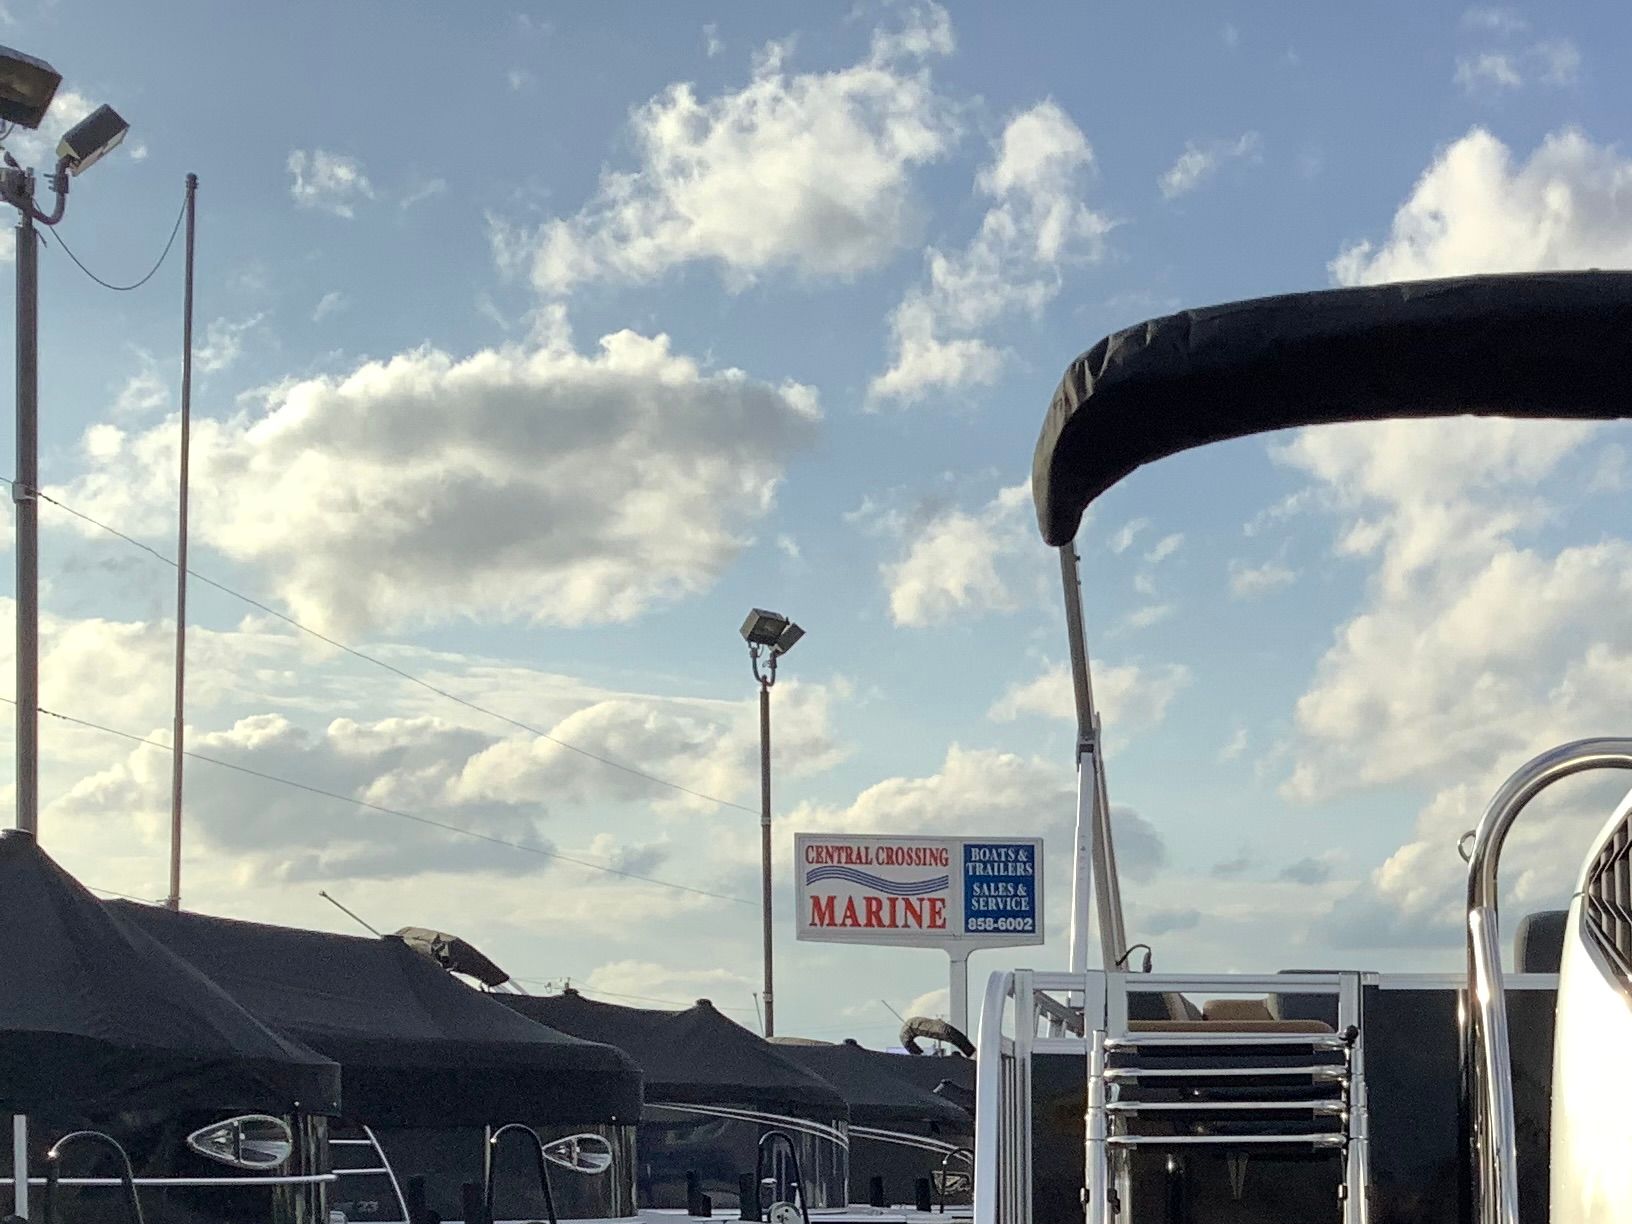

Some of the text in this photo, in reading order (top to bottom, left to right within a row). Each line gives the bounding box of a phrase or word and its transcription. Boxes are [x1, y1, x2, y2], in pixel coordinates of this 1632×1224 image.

[805, 845, 949, 867] CENTRAL CROSSING
[971, 848, 1028, 862] BOATS &
[966, 862, 1033, 876] TRAILERS
[973, 883, 1027, 897] SALES &
[971, 897, 1030, 911] SERVICE
[809, 895, 947, 929] MARINE
[968, 917, 1033, 931] 858-6002
